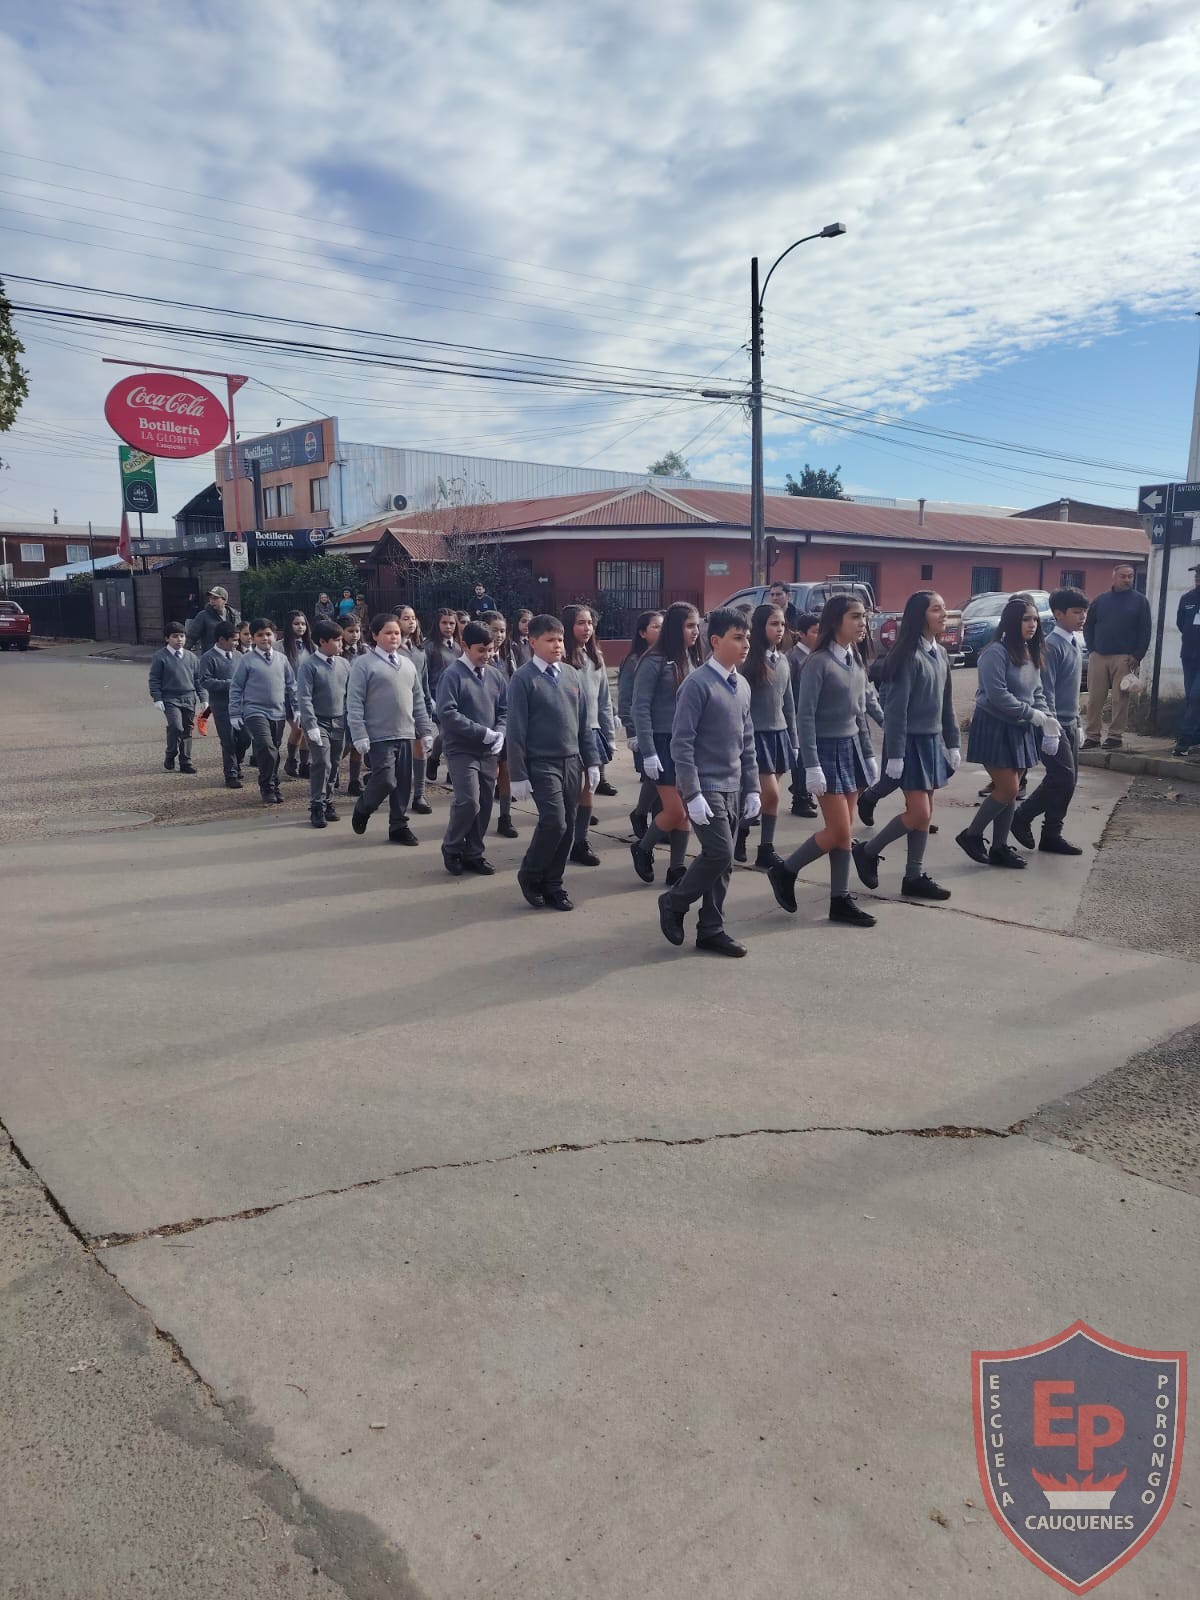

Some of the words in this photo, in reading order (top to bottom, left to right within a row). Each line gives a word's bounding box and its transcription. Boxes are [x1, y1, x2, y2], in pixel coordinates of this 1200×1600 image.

[139, 417, 200, 436] Botillería
[141, 430, 154, 441] LA
[156, 433, 200, 447] GLORITA
[236, 545, 242, 554] E
